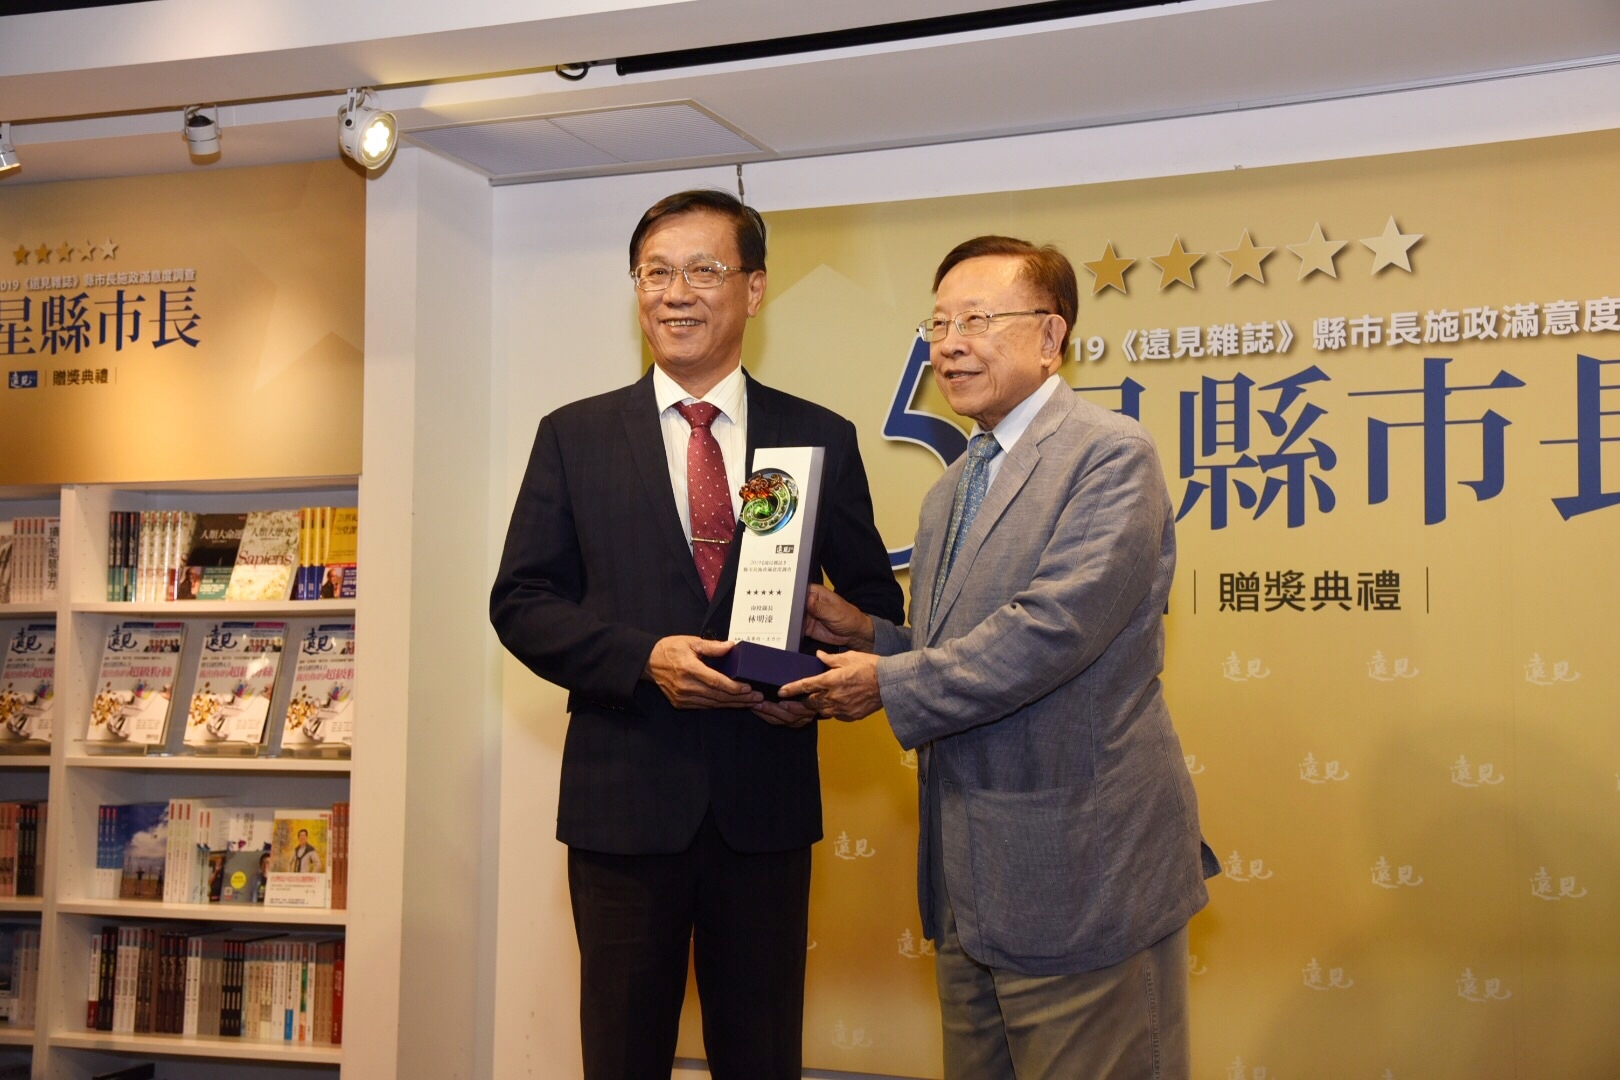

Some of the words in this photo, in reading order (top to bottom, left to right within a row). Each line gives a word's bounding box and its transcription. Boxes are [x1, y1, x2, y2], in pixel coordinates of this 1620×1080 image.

[53, 367, 109, 387] 贈獎典禮
[236, 550, 293, 568] Sapiens
[1219, 570, 1402, 613] 贈獎典禮
[11, 627, 42, 654] 遠見
[107, 624, 138, 652] 遠見
[205, 624, 238, 652] 遠見
[302, 627, 336, 655] 遠見
[1222, 650, 1271, 682] 遠見
[1366, 649, 1420, 682] 遠見
[1523, 652, 1581, 685] 遠見
[1299, 752, 1350, 784] 遠見
[1450, 754, 1505, 787] 遠見
[833, 830, 876, 860] 遠見
[1224, 850, 1274, 882] 遠見
[1370, 856, 1424, 889] 遠見
[1529, 866, 1588, 900] 遠見
[1302, 957, 1354, 991] 遠見
[1456, 967, 1512, 1002] 遠見
